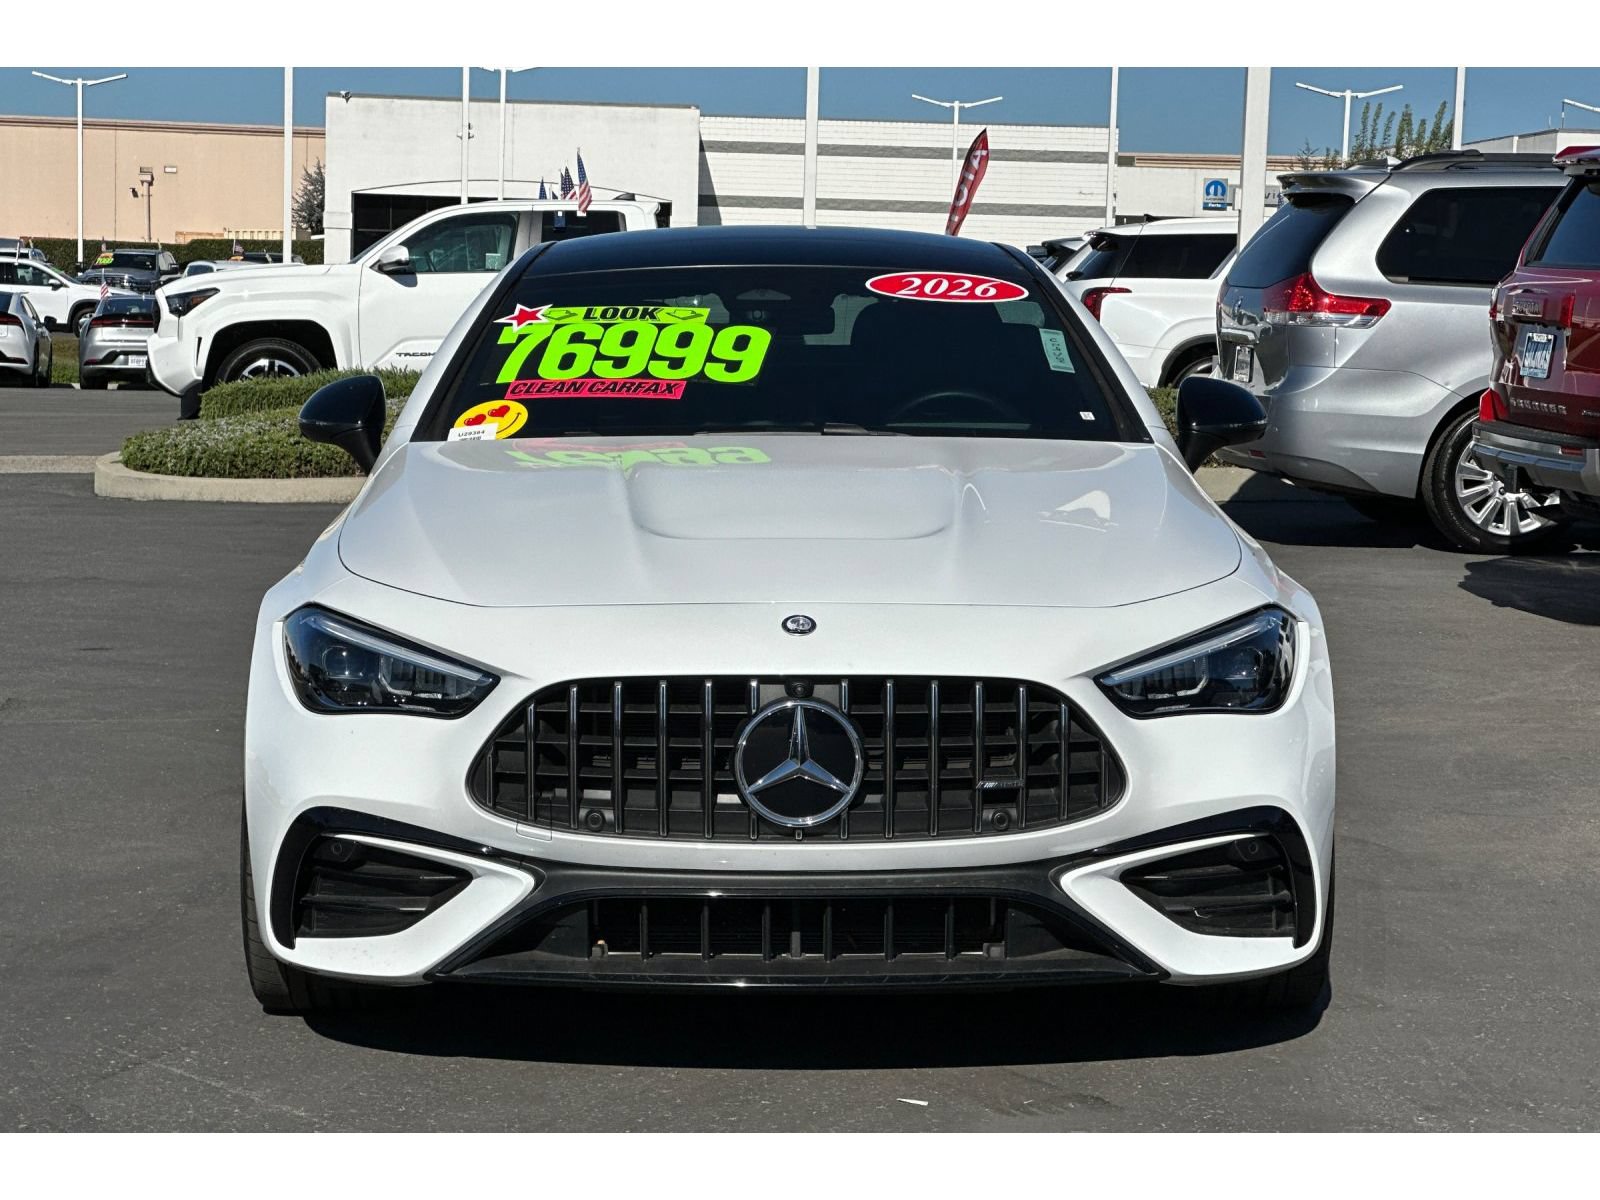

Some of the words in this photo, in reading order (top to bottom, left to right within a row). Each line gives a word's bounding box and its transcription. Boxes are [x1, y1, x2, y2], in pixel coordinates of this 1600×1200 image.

[896, 277, 1001, 297] 2026
[583, 306, 661, 321] LOOK
[496, 322, 772, 382] 76999
[509, 381, 588, 394] CLEAN
[587, 381, 679, 395] CARFAX
